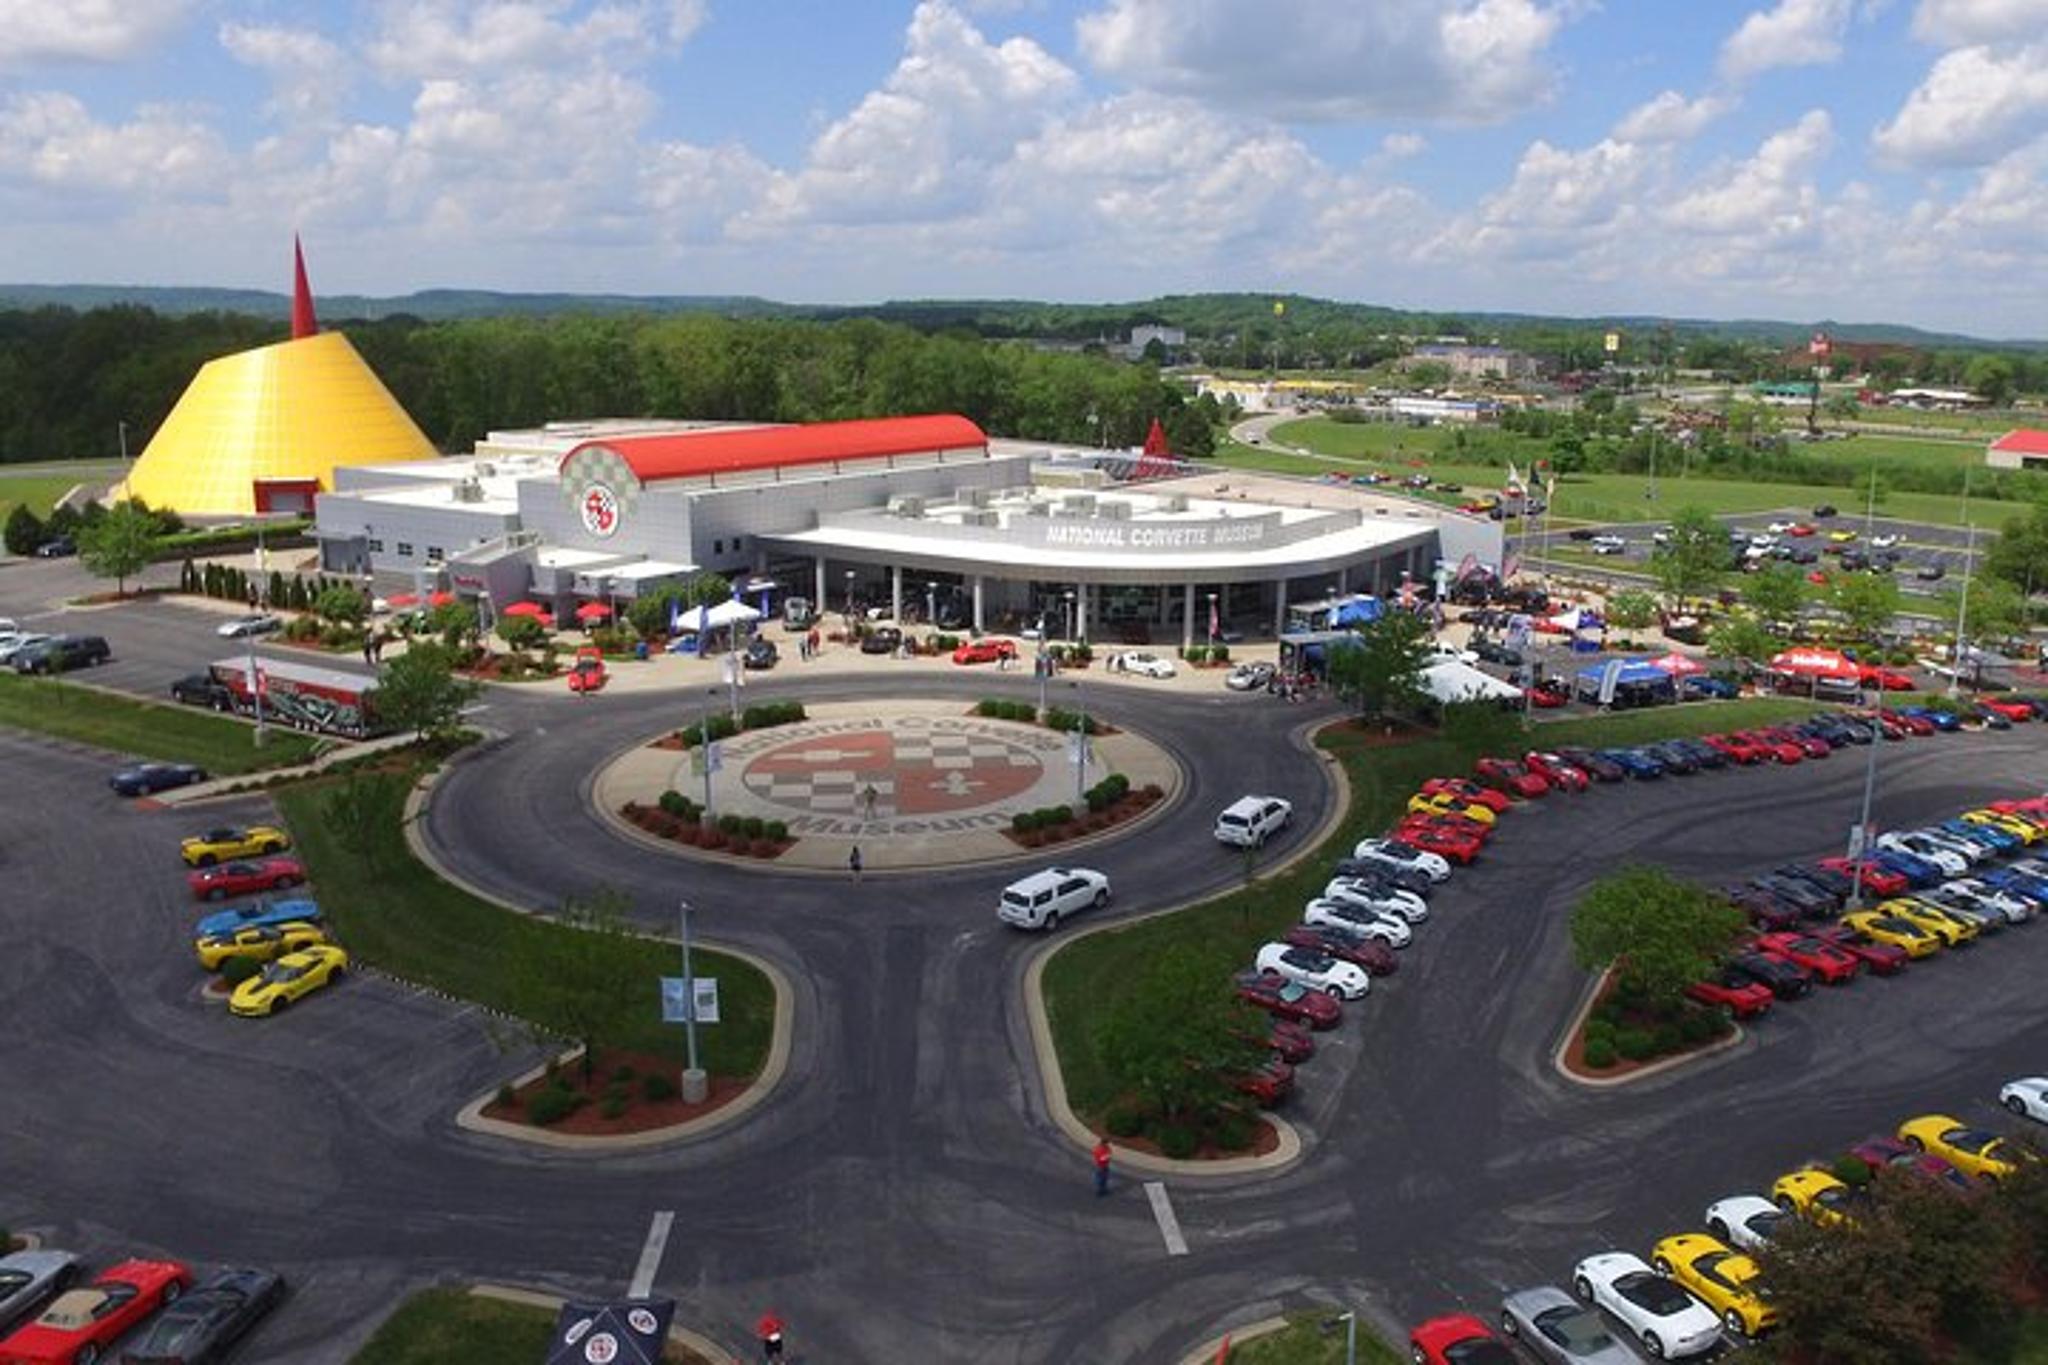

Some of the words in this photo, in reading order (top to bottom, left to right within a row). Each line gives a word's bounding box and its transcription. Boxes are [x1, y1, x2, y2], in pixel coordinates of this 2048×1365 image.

[1047, 526, 1124, 547] NATIONAL
[1131, 528, 1206, 546] CORVETTE
[1214, 523, 1264, 542] MUSEUM
